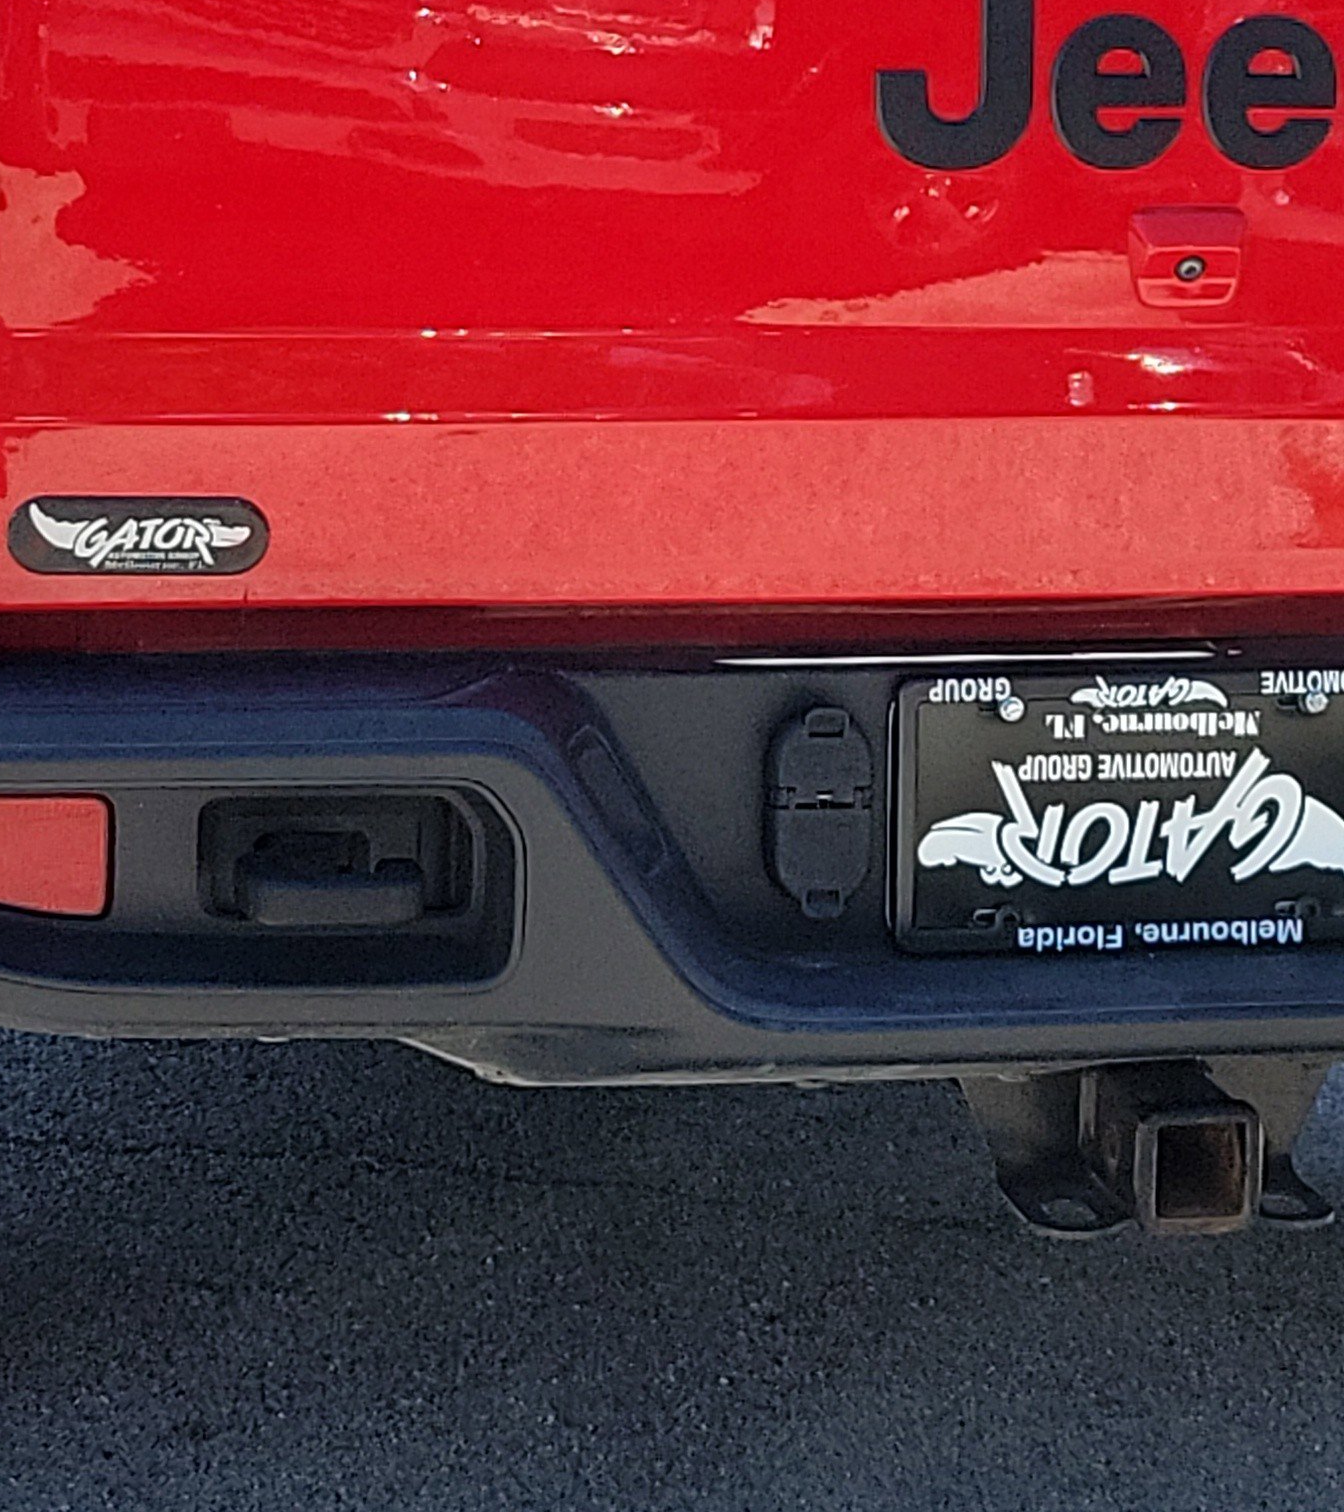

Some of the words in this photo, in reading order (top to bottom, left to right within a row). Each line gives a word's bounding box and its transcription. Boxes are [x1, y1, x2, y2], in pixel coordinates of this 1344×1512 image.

[74, 518, 215, 568] GATOR
[929, 677, 1011, 702] GROUP
[1095, 675, 1190, 707] GATOR
[1046, 714, 1085, 738] FL
[1092, 711, 1261, 736] Melbourne,
[1018, 754, 1092, 780] GROUP
[1098, 751, 1236, 780] AUTOMOTIVE
[991, 747, 1303, 885] GATOR
[1017, 924, 1124, 952] Florida
[1135, 919, 1303, 944] Melbourne,
